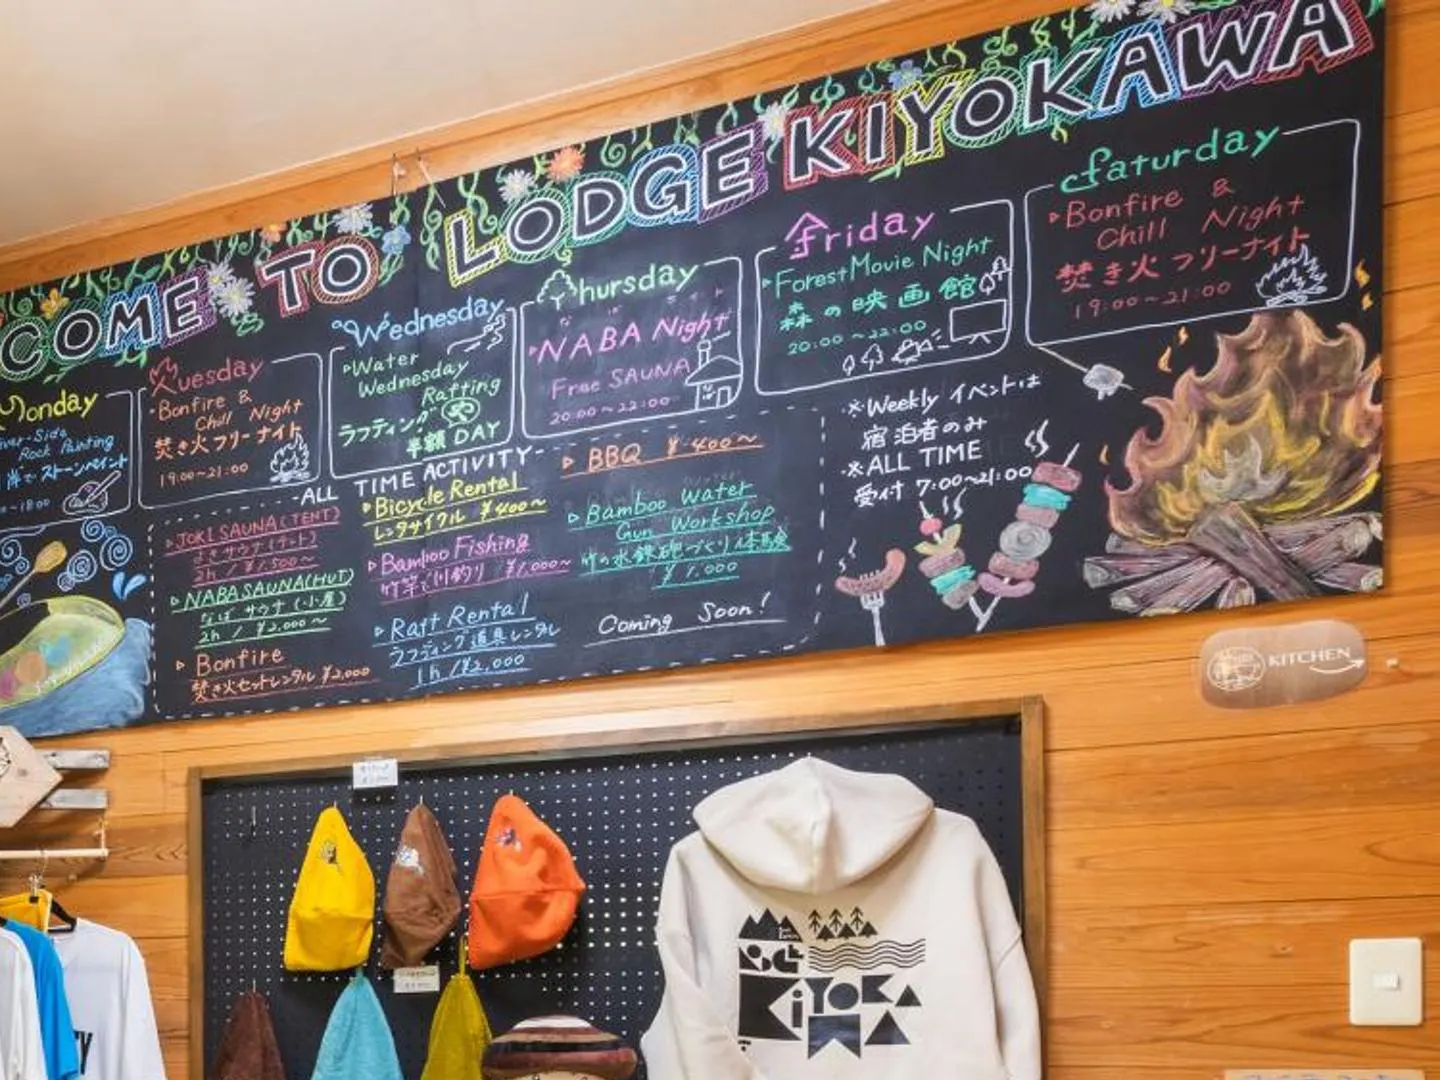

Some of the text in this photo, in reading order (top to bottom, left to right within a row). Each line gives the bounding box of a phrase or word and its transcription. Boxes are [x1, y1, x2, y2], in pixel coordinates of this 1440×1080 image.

[262, 240, 374, 312] TO
[452, 137, 757, 280] LODGE
[788, 0, 1360, 184] KIYOKAWA
[1067, 178, 1234, 228] Bonfire &
[1096, 195, 1305, 250] Chill Night
[784, 211, 935, 260] Friday
[774, 237, 993, 298] Forest Movie Night
[1055, 226, 1310, 292] 焚き火フリーナイト
[332, 298, 506, 347] Wednesday
[779, 274, 979, 331] 森の映画館
[537, 310, 731, 365] NABA Night
[149, 356, 264, 397] Tuesday
[351, 353, 420, 376] Water
[358, 359, 470, 397] Wednesday
[550, 358, 690, 400] Free SAUNA
[158, 395, 226, 422] Bonfire
[422, 377, 501, 406] Rafting
[194, 399, 303, 430] Chill Night
[338, 403, 438, 447] ラフティング
[454, 421, 501, 446] DAY
[861, 416, 987, 451] 宿泊者のみ
[300, 445, 532, 506] ALL TIME ACTIVITY
[588, 443, 643, 472] BBQ
[918, 440, 984, 469] TIME
[375, 470, 519, 519] Bicycle Rental
[586, 480, 753, 526] Bamboo Water
[854, 481, 904, 508] 受付
[616, 500, 775, 541] Gun Workshop
[380, 532, 530, 576] Bamboo Fishing
[184, 586, 238, 611] NABA
[391, 592, 529, 641] Raft Rental
[598, 591, 771, 635] Coming Soon!
[197, 648, 285, 678] Bonfire
[1268, 646, 1351, 669] KITCHEN
